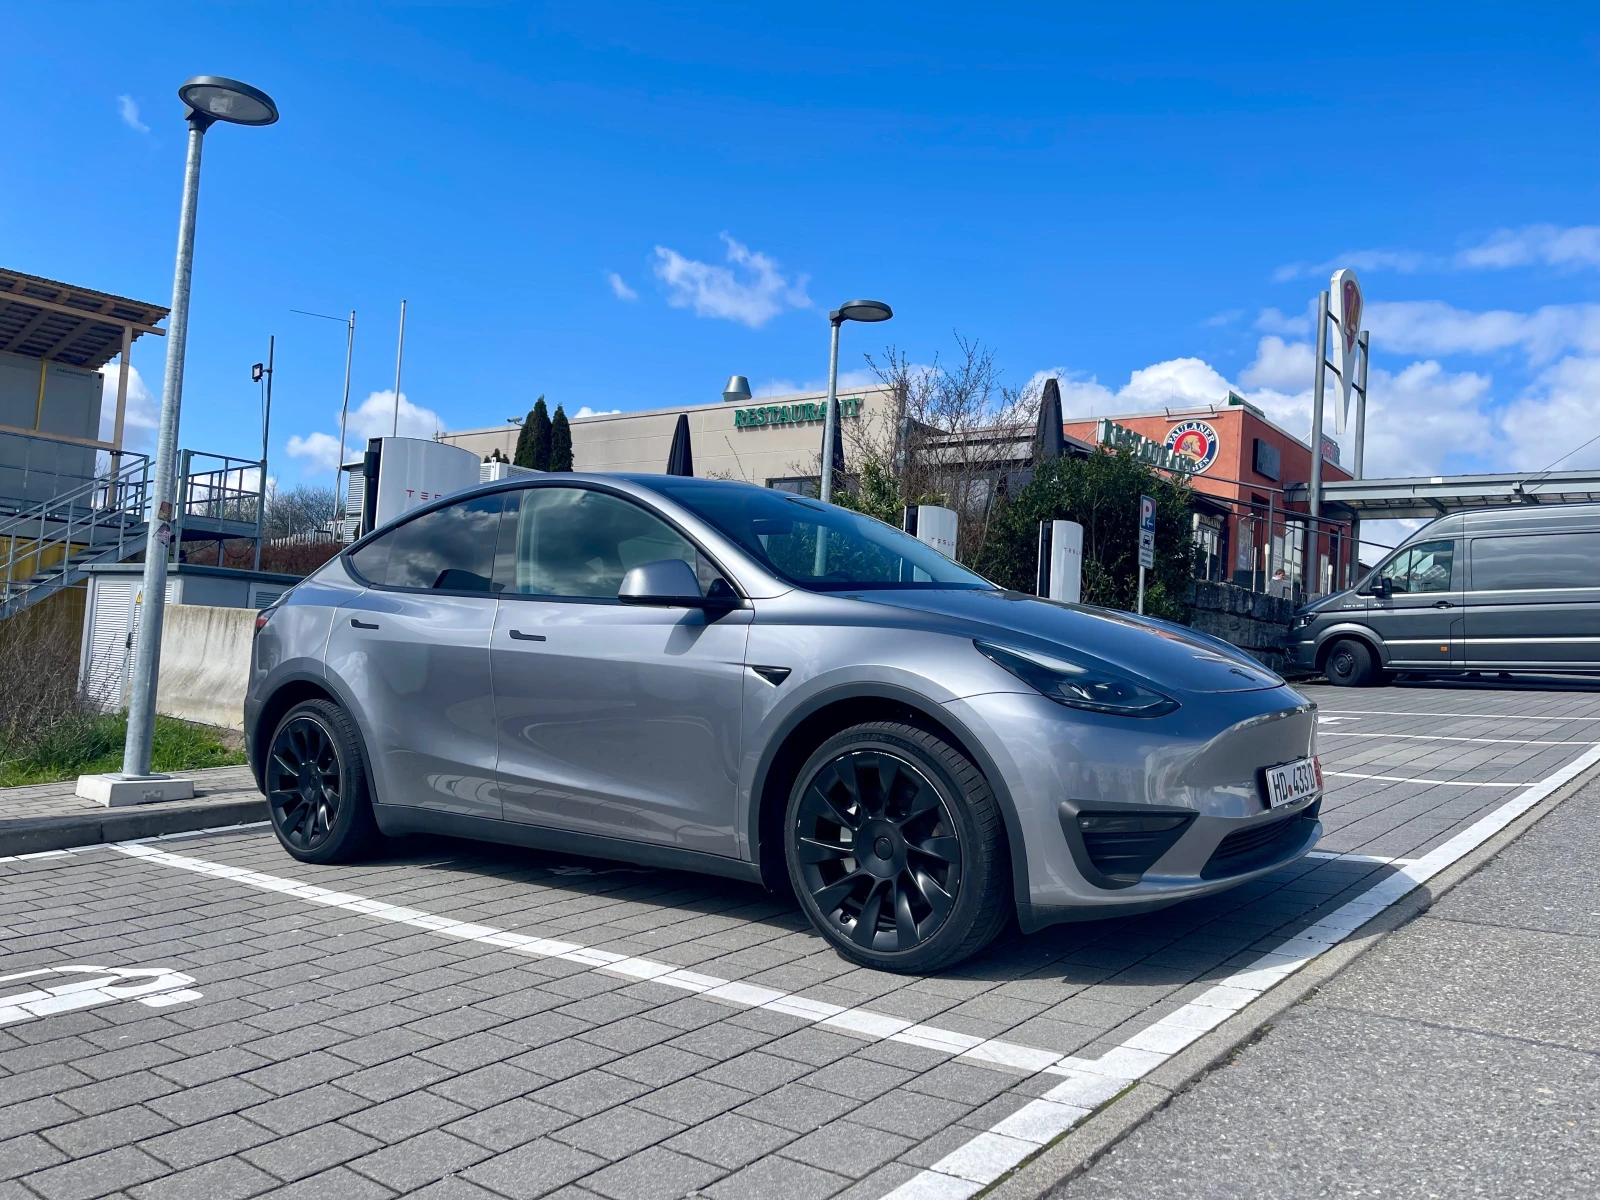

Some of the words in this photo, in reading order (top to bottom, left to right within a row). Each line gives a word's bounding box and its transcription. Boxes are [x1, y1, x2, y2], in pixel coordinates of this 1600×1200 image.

[1168, 422, 1215, 445] PAULANER
[1192, 457, 1210, 472] HEN
[1142, 499, 1153, 527] P
[1272, 771, 1288, 802] HD
